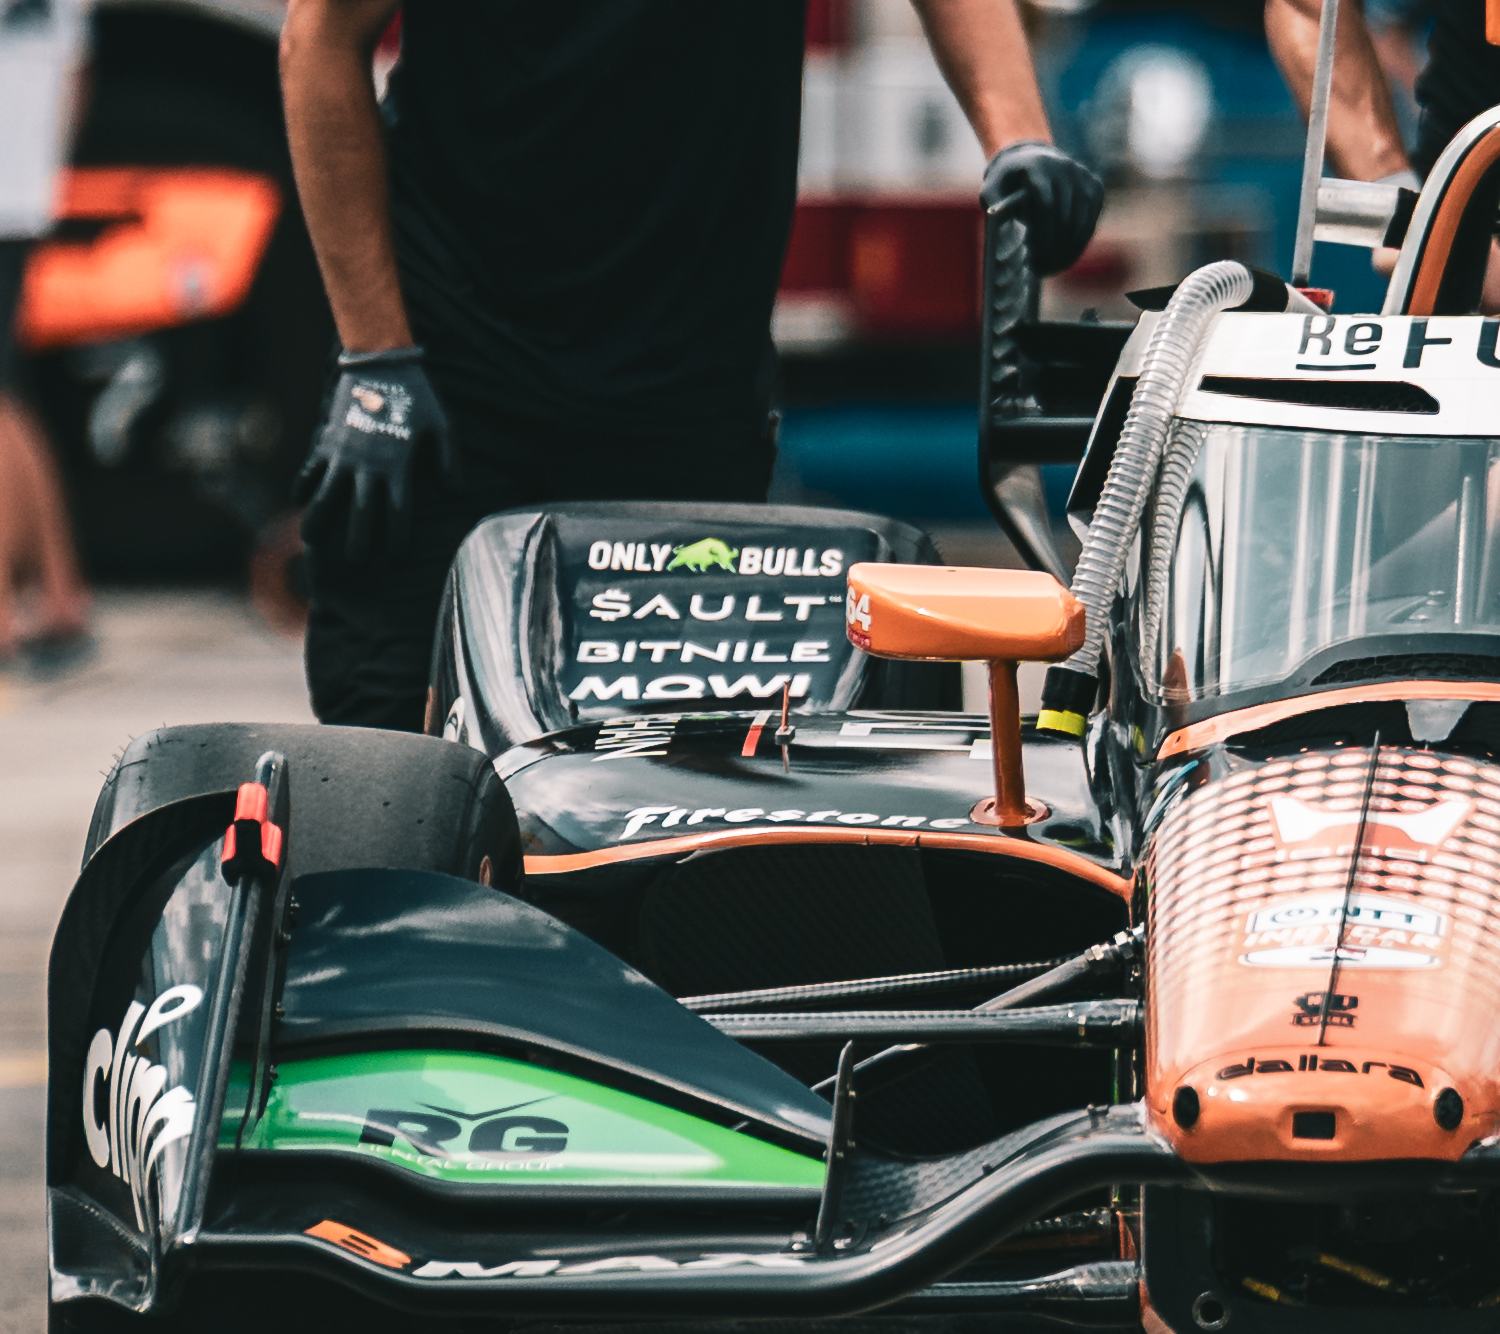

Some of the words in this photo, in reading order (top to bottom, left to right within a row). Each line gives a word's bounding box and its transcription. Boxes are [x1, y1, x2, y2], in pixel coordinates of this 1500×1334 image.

[588, 540, 671, 571] ONLY
[738, 546, 843, 576] BULLS
[576, 641, 831, 663] BITNILE
[619, 805, 971, 840] Firestone
[1214, 1053, 1425, 1089] dallara
[358, 1107, 570, 1160] RG
